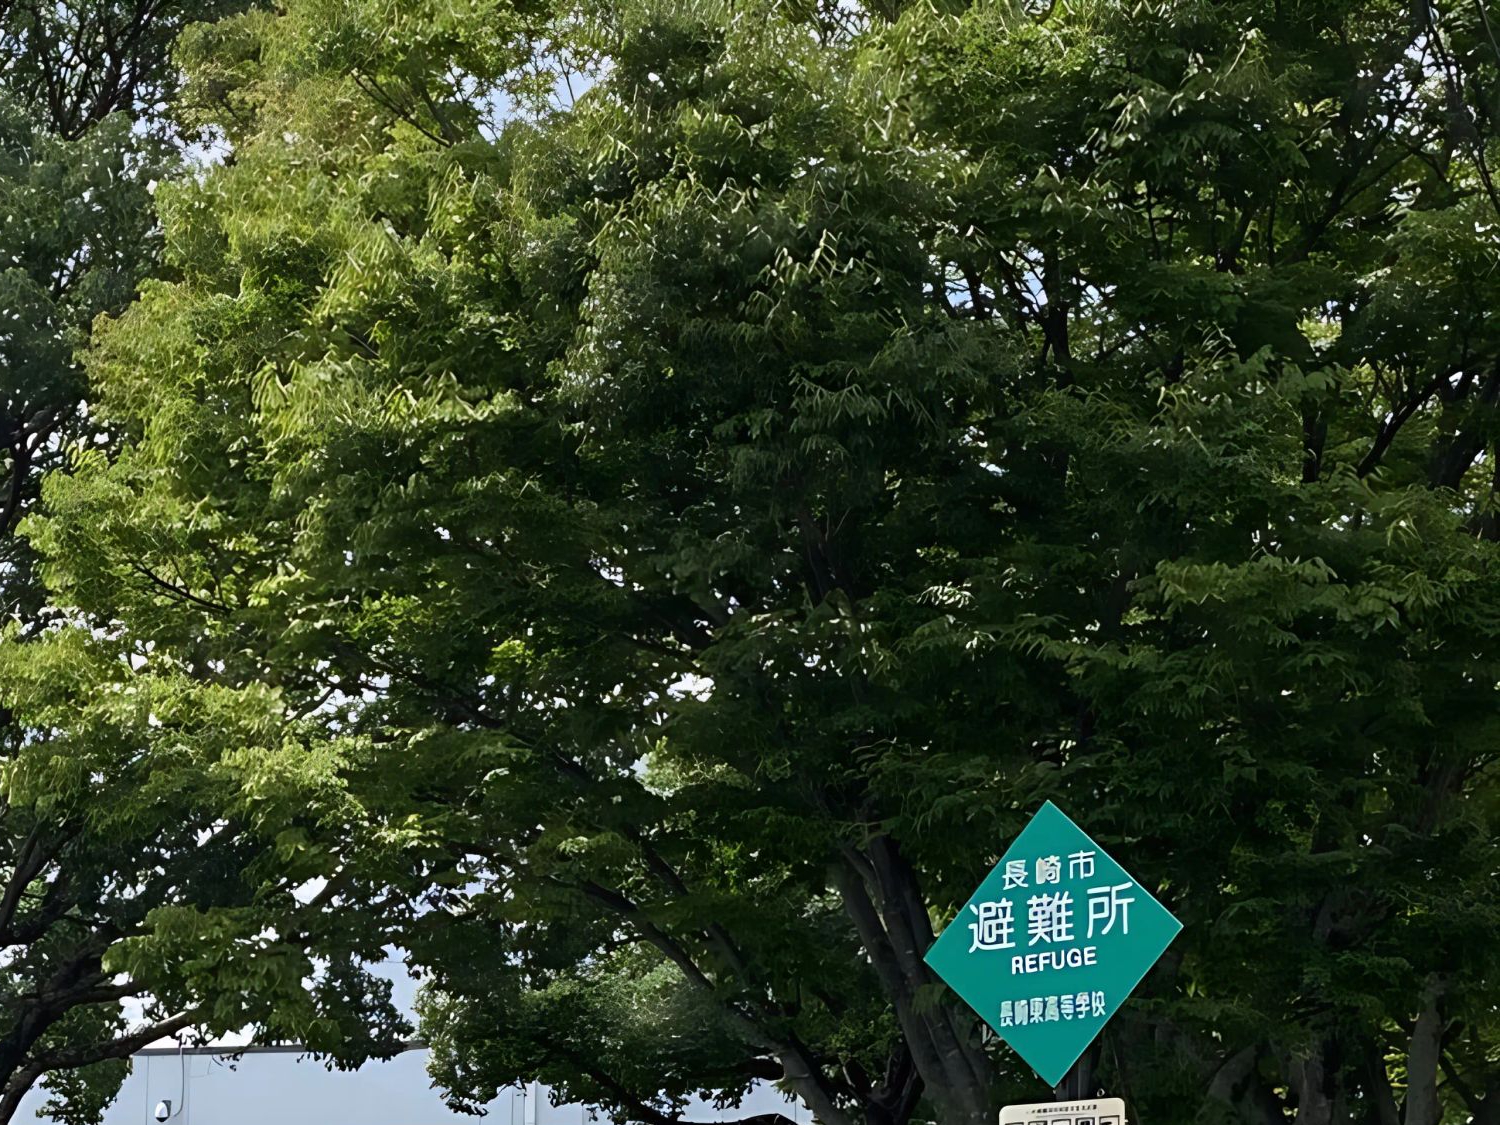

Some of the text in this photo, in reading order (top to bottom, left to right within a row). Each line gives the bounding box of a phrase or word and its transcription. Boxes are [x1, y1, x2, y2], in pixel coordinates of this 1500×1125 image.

[1002, 850, 1096, 890] 長崎市
[968, 881, 1135, 953] 避難所
[1011, 947, 1098, 974] REFUGE
